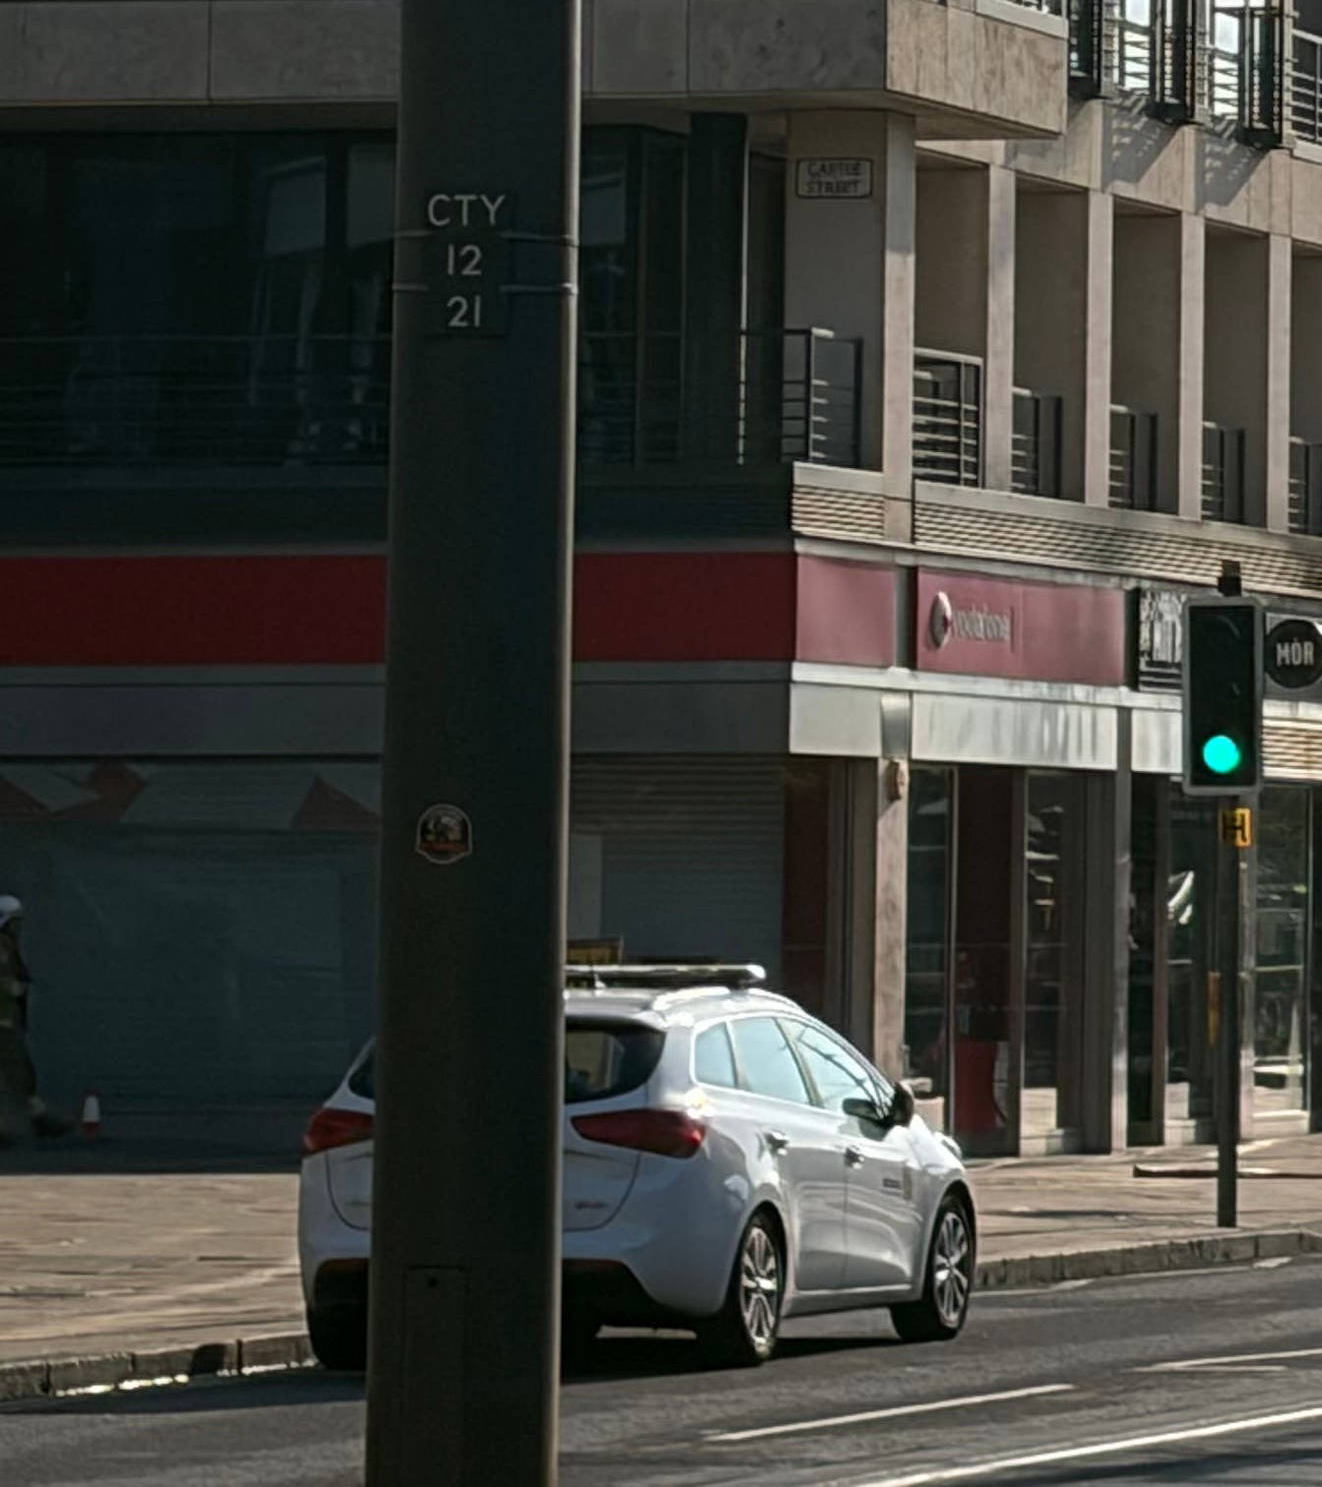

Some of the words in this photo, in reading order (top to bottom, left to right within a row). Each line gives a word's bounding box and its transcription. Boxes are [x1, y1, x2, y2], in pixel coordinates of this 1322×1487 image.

[427, 193, 506, 227] CTY
[446, 243, 483, 277] 12
[446, 294, 482, 329] 21
